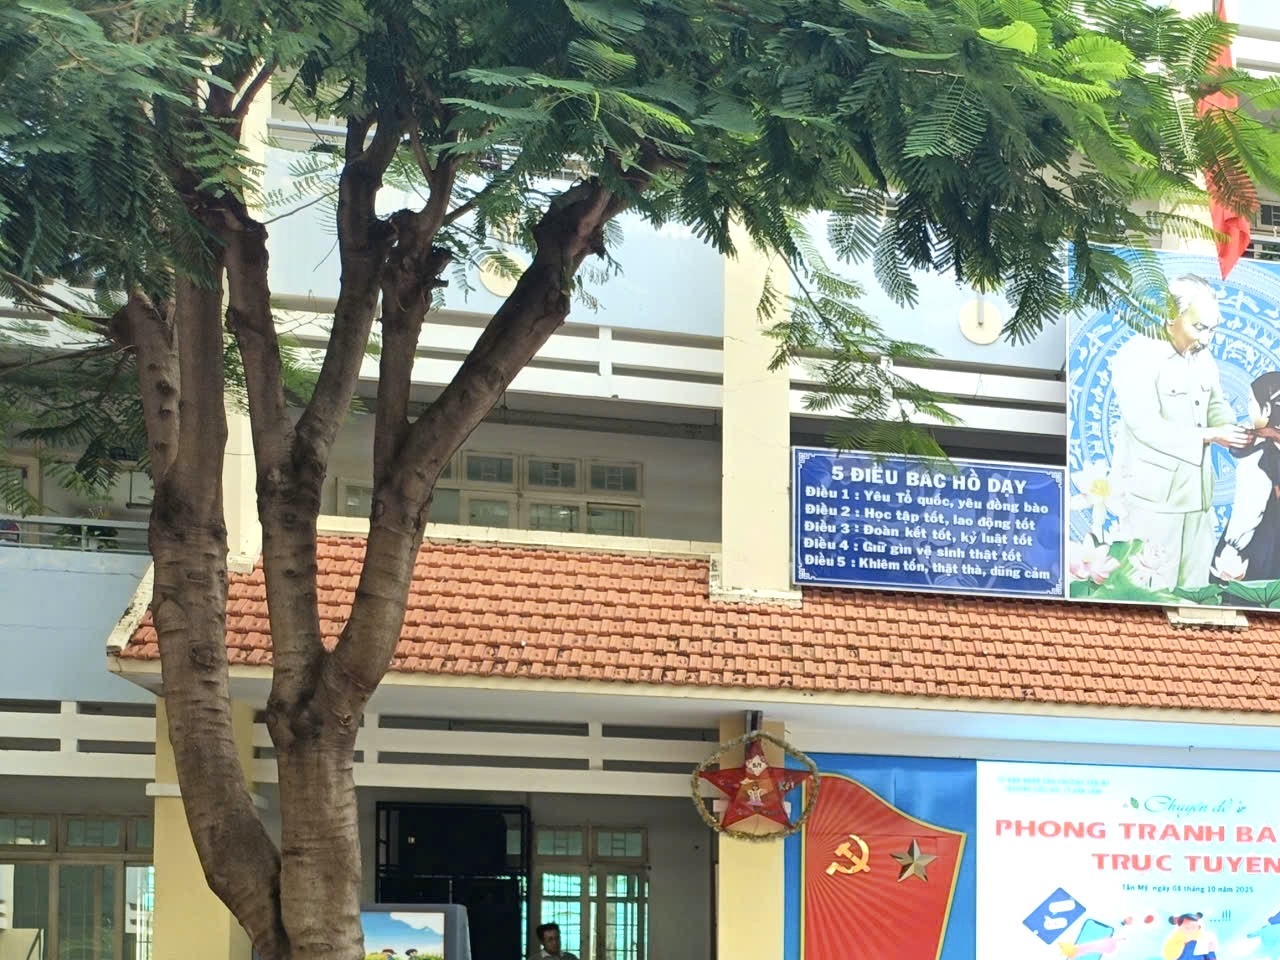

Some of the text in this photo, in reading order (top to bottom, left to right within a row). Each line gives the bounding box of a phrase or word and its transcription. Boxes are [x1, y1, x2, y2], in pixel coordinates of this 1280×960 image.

[832, 466, 844, 481] 5
[850, 462, 898, 485] ĐIỀU
[952, 468, 980, 491] HỒ
[988, 478, 1027, 497] DẠY
[805, 485, 1049, 513] Điều 1 Yêu Tổ quốc, yêu đồng bào
[805, 502, 1036, 530] Điều 2 Học tập tốt, lao động tốt
[804, 519, 1033, 547] Điều 3 Đoàn kết tốt, kỷ luật tốt
[804, 536, 1022, 562] Điều 4 Giữ gìn vệ sinh thật tốt
[805, 552, 1051, 579] Điều 5 Khiêm tốn, thật thà, dũng cảm
